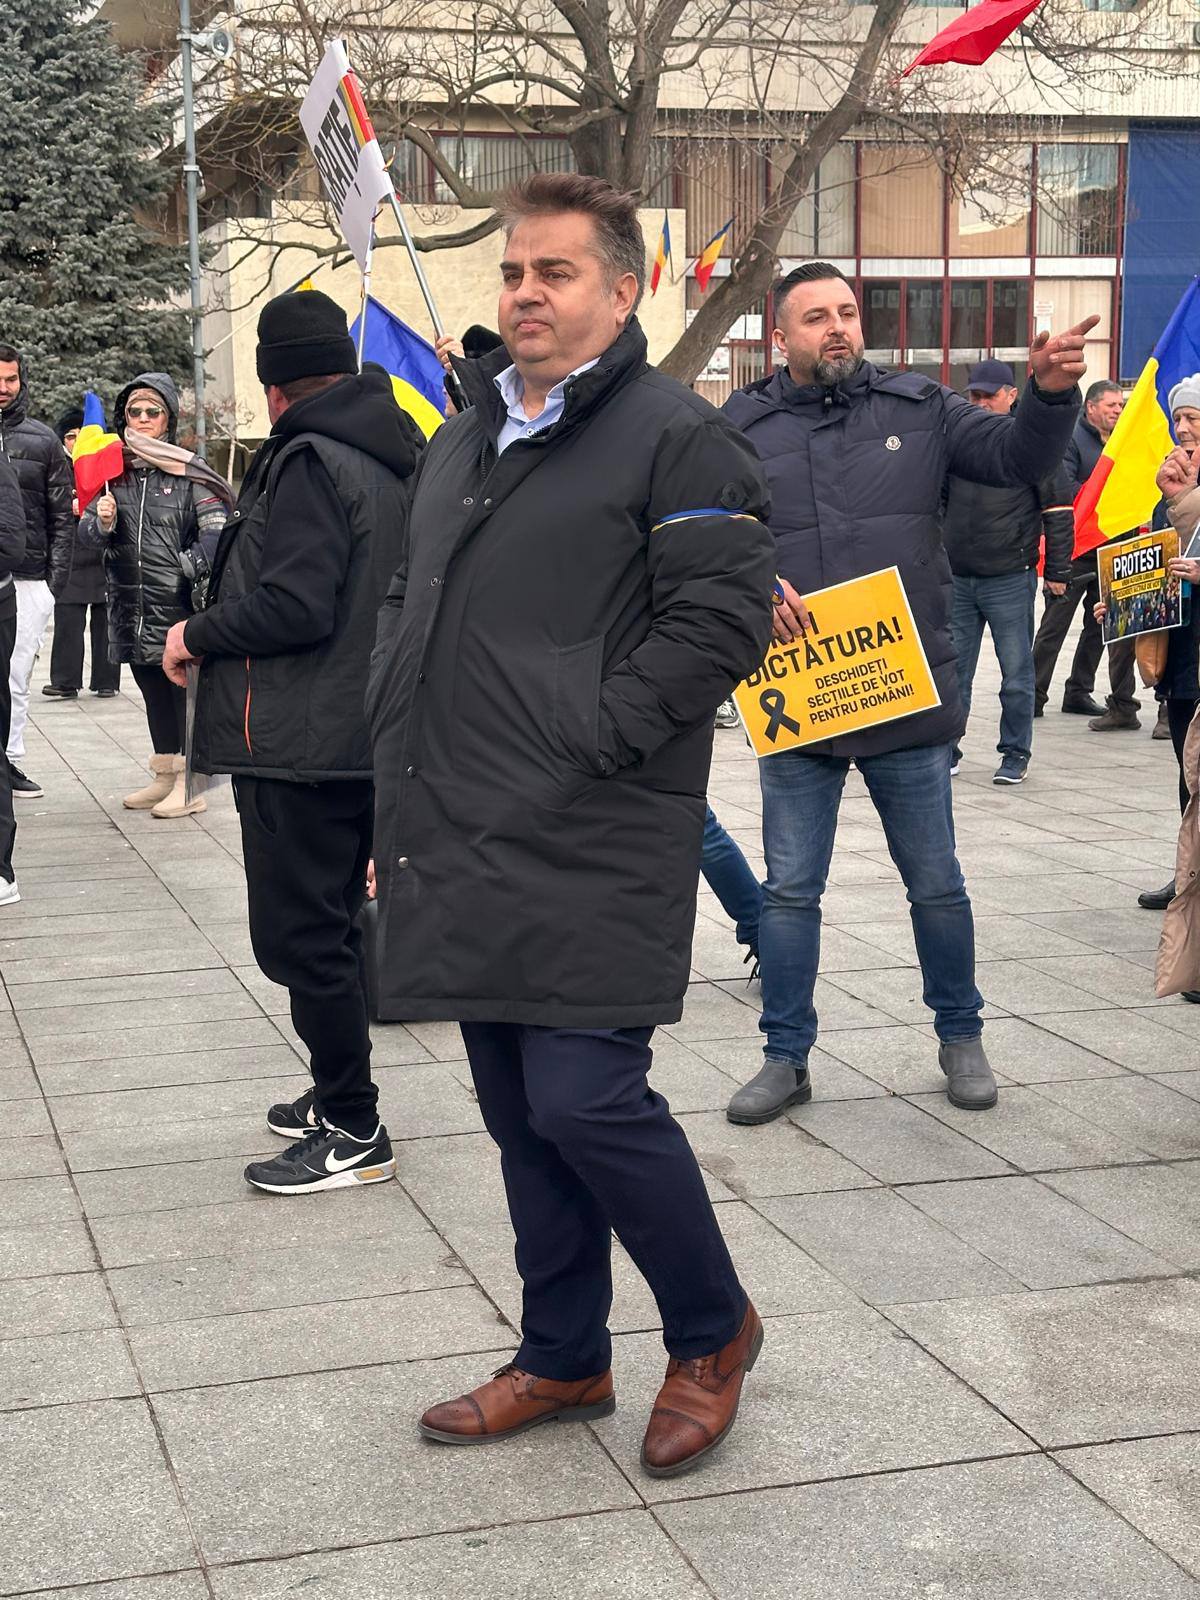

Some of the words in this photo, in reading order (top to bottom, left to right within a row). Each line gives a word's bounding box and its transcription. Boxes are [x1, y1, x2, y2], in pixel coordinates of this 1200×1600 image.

[1114, 546, 1161, 579] PROTEST
[807, 683, 861, 708] SECȚIILE
[861, 677, 879, 692] DE
[879, 669, 905, 687] VOT
[815, 658, 888, 690] DESCHIDEȚI
[809, 700, 859, 725] PENTRU
[859, 684, 915, 710] ROMÂNI!
